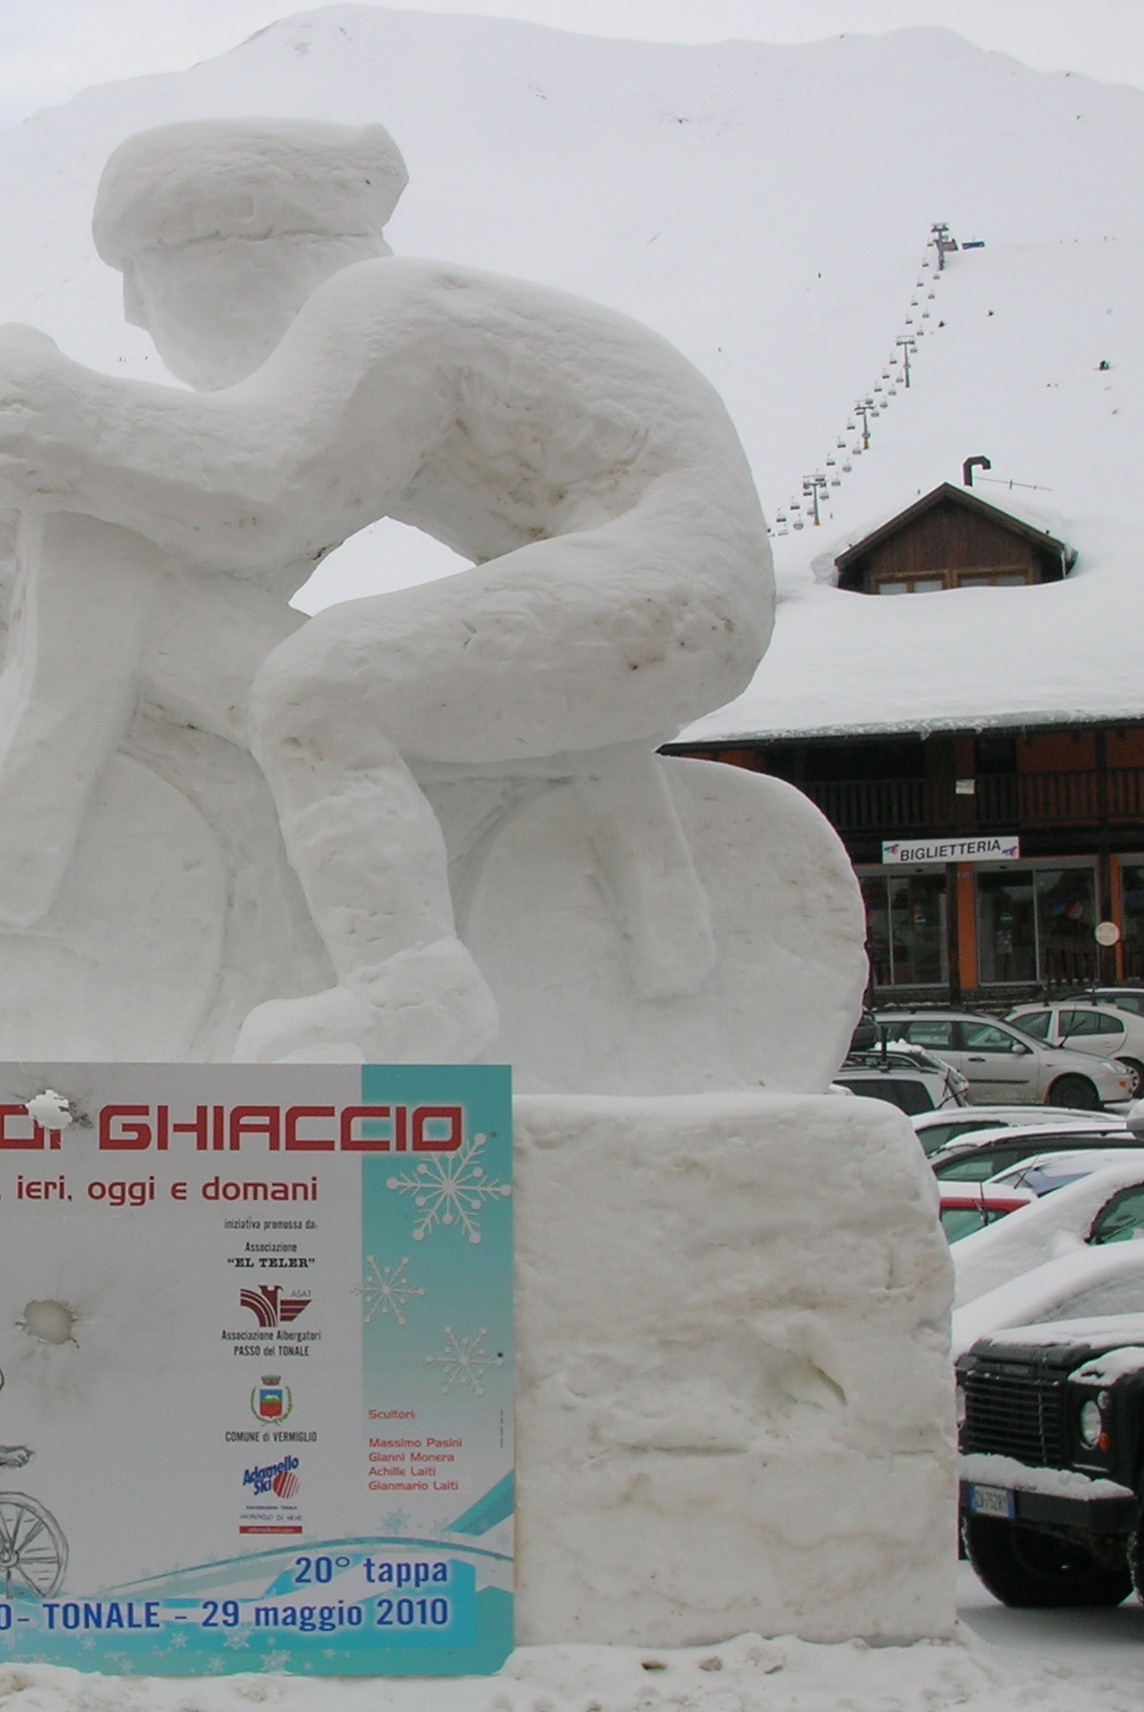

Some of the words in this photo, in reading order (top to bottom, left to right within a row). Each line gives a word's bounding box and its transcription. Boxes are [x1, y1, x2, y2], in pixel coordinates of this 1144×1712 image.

[900, 840, 1001, 862] BIGLIETTERIA
[99, 1104, 462, 1152] GHIACCIO
[17, 1175, 72, 1202] ieri,
[87, 1176, 156, 1206] oggi
[171, 1183, 187, 1201] e
[202, 1177, 318, 1202] domani
[224, 1215, 261, 1230] iniziativa
[263, 1217, 303, 1231] promossa
[305, 1217, 318, 1230] da:
[245, 1241, 298, 1253] Associazione
[221, 1330, 274, 1341] Associazione
[276, 1330, 322, 1343] Albergatori
[233, 1345, 260, 1357] PASSO
[263, 1346, 276, 1357] del
[278, 1345, 310, 1357] TONALE
[225, 1431, 260, 1443] COMUNE
[262, 1431, 271, 1442] di
[273, 1431, 318, 1443] VERMIGLIO
[368, 1438, 422, 1448] Massimo
[426, 1437, 463, 1448] Pasini
[368, 1452, 405, 1462] Gianni
[409, 1452, 455, 1462] Monera
[242, 1454, 300, 1486] Adamello
[368, 1466, 406, 1476] Achille
[411, 1466, 437, 1477] Laiti
[253, 1478, 272, 1496] Ski
[368, 1480, 429, 1491] Gianmario
[433, 1480, 459, 1491] Laiti
[294, 1556, 351, 1584] 20°
[363, 1557, 449, 1588] tappa
[43, 1602, 160, 1630] TONALE
[202, 1600, 240, 1627] 29
[255, 1598, 363, 1632] maggio
[376, 1598, 449, 1626] 2010
